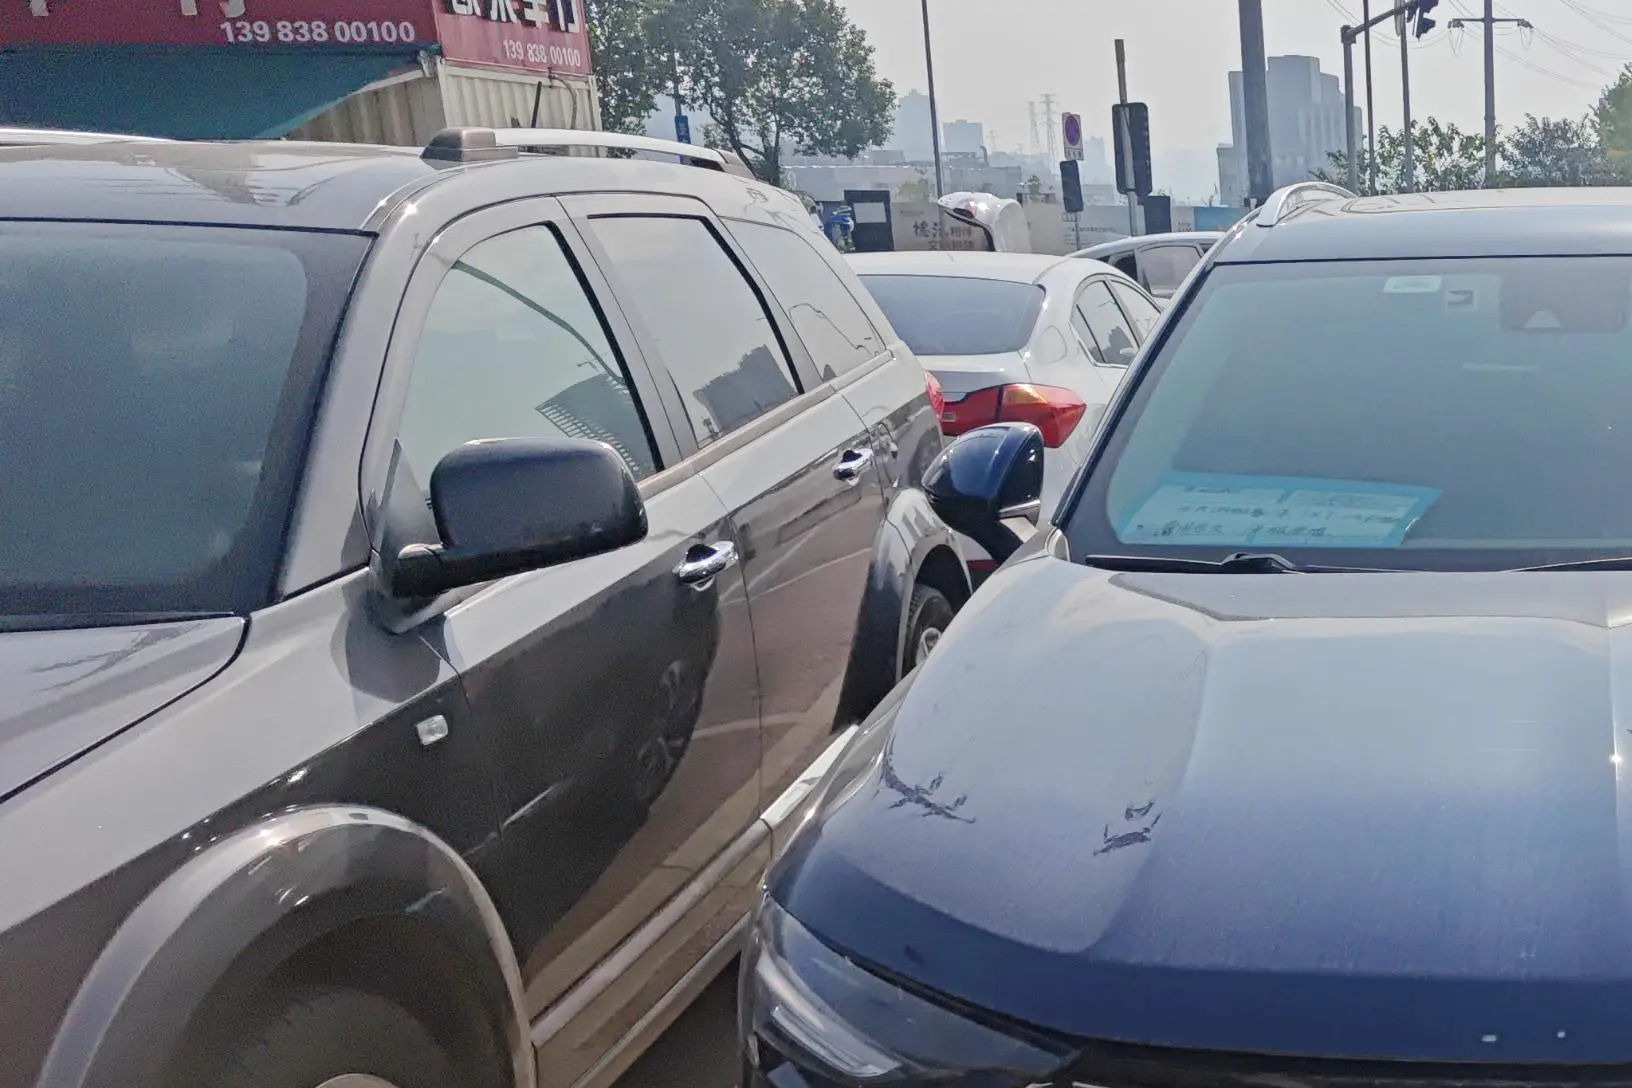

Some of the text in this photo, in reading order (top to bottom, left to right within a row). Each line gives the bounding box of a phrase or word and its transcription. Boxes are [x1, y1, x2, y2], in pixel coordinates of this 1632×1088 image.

[220, 21, 416, 43] 139 838 00100
[503, 40, 581, 67] 139 838 00100
